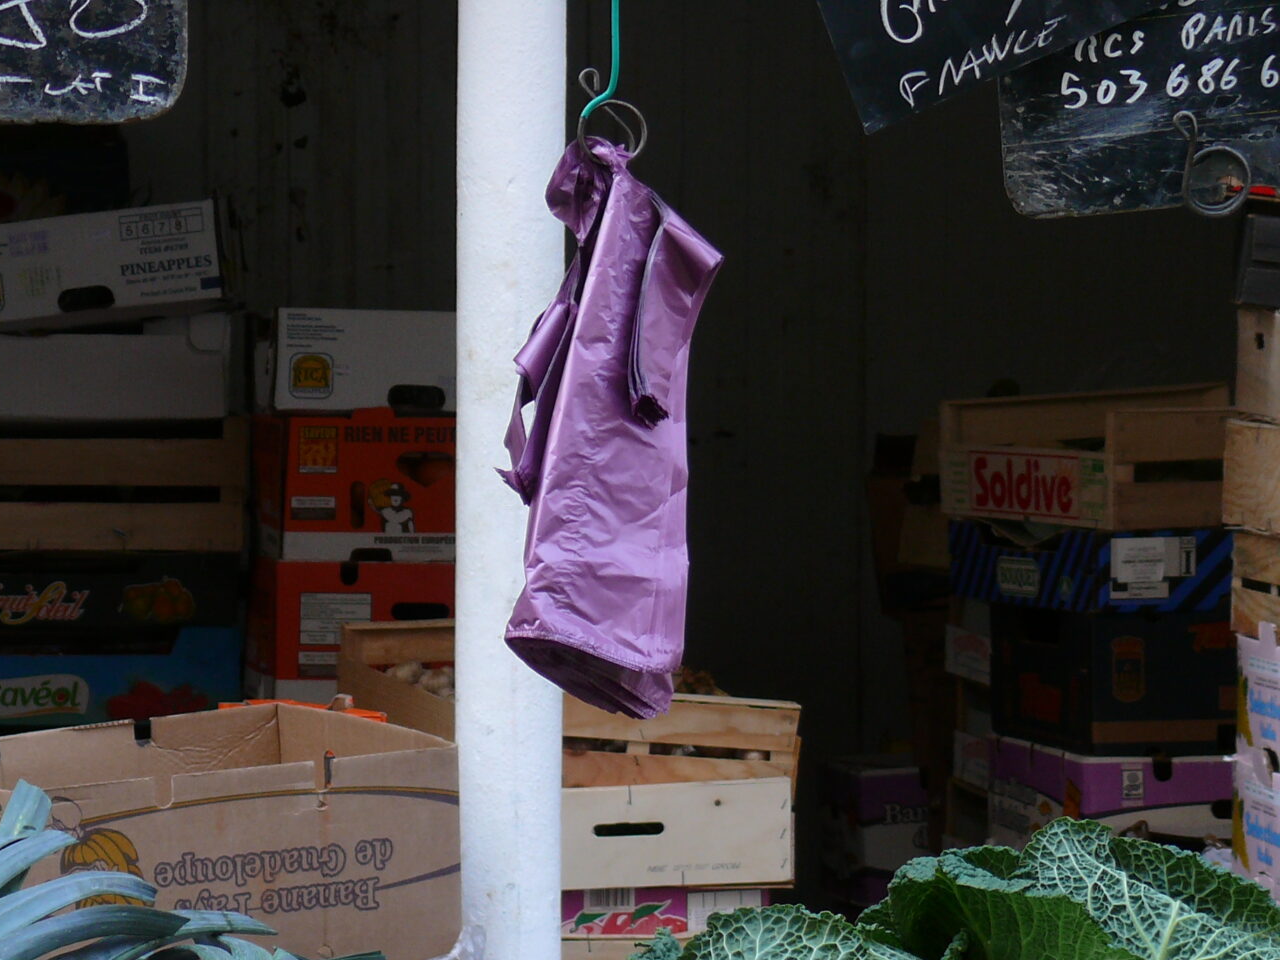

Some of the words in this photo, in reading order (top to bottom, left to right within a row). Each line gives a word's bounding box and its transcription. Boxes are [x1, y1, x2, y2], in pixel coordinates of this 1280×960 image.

[1061, 70, 1149, 109] 503
[1166, 58, 1241, 97] 686
[120, 254, 212, 276] PINEAPPLES
[344, 426, 380, 443] RIEN
[387, 426, 408, 443] NE
[975, 457, 1073, 513] Soldive
[154, 842, 347, 888] Guadeloupe
[354, 837, 393, 871] de
[261, 877, 380, 915] Banane
